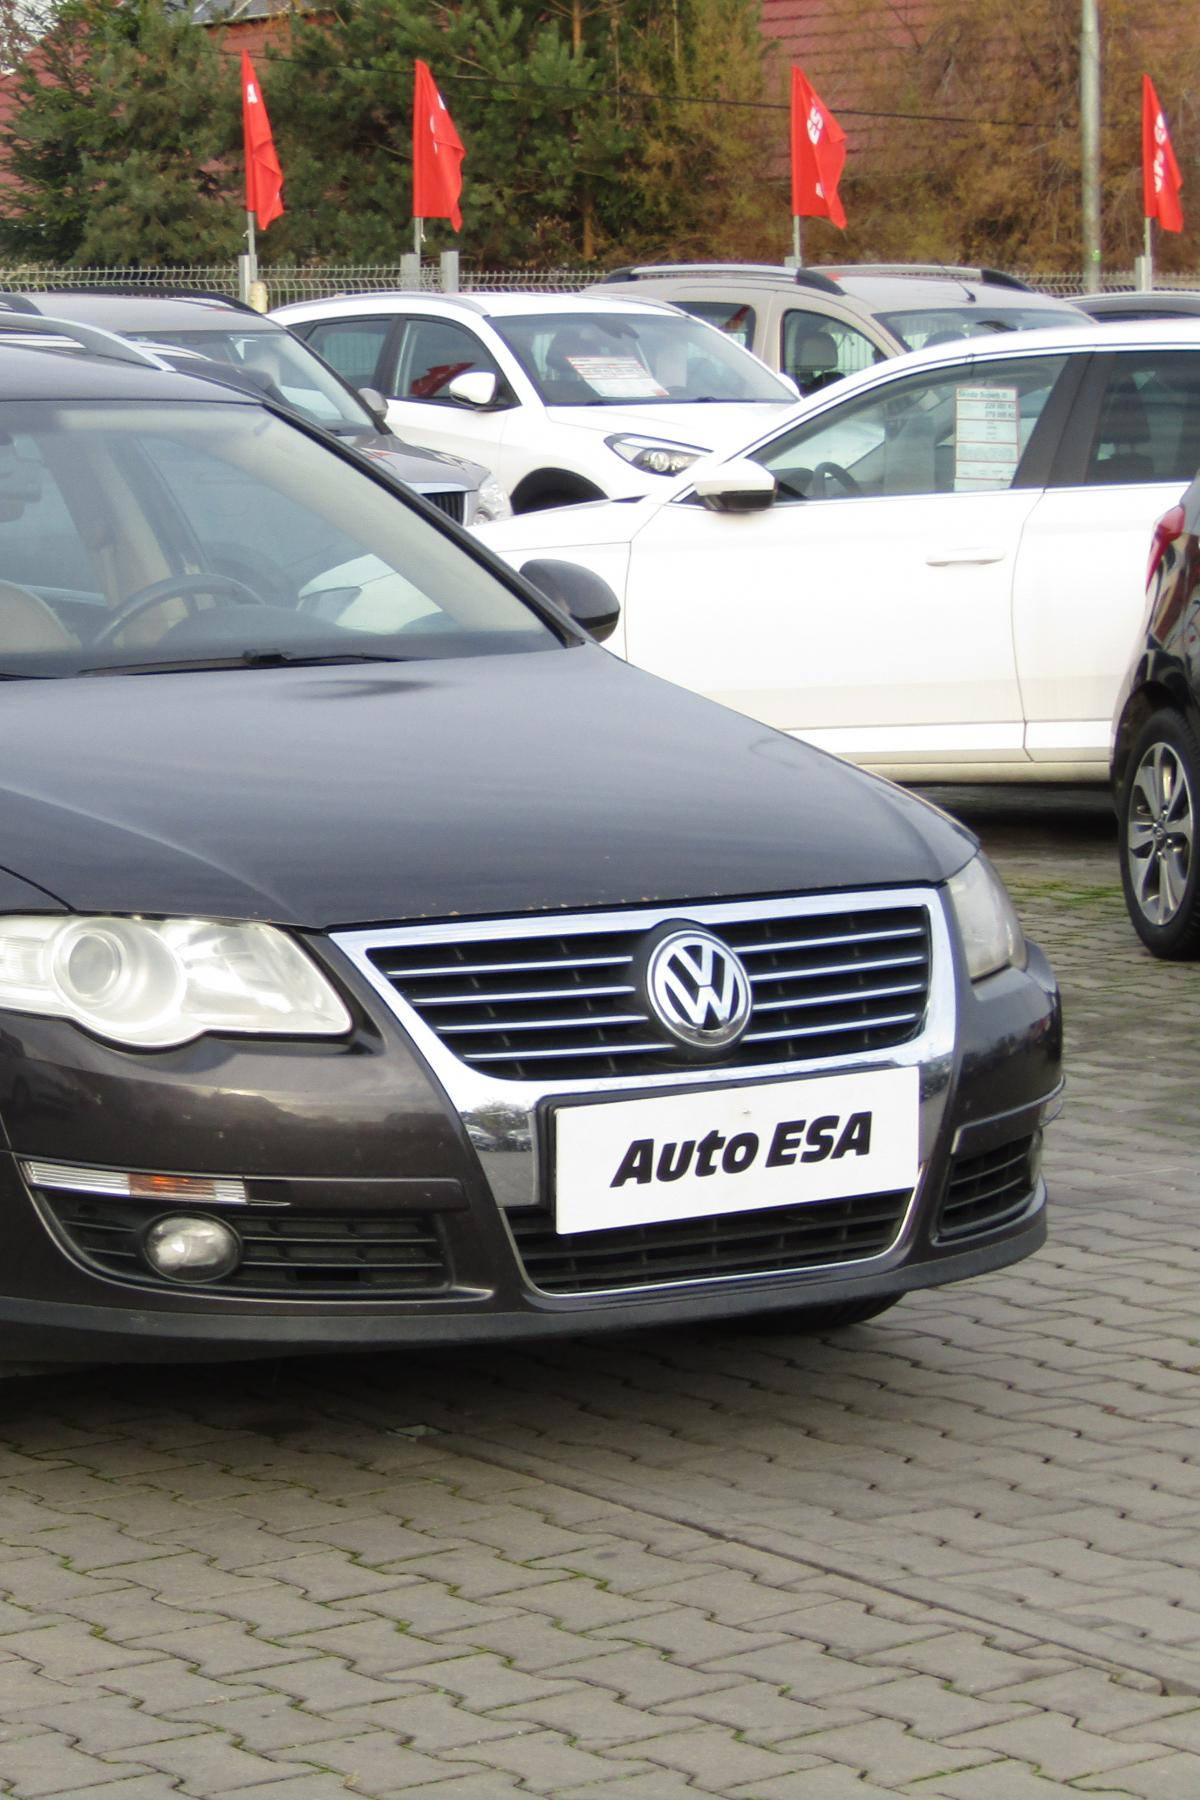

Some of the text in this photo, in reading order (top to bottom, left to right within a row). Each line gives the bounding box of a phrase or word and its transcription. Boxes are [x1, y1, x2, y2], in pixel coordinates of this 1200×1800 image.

[650, 936, 748, 1040] VW
[608, 1110, 873, 1188] Auto ESA
